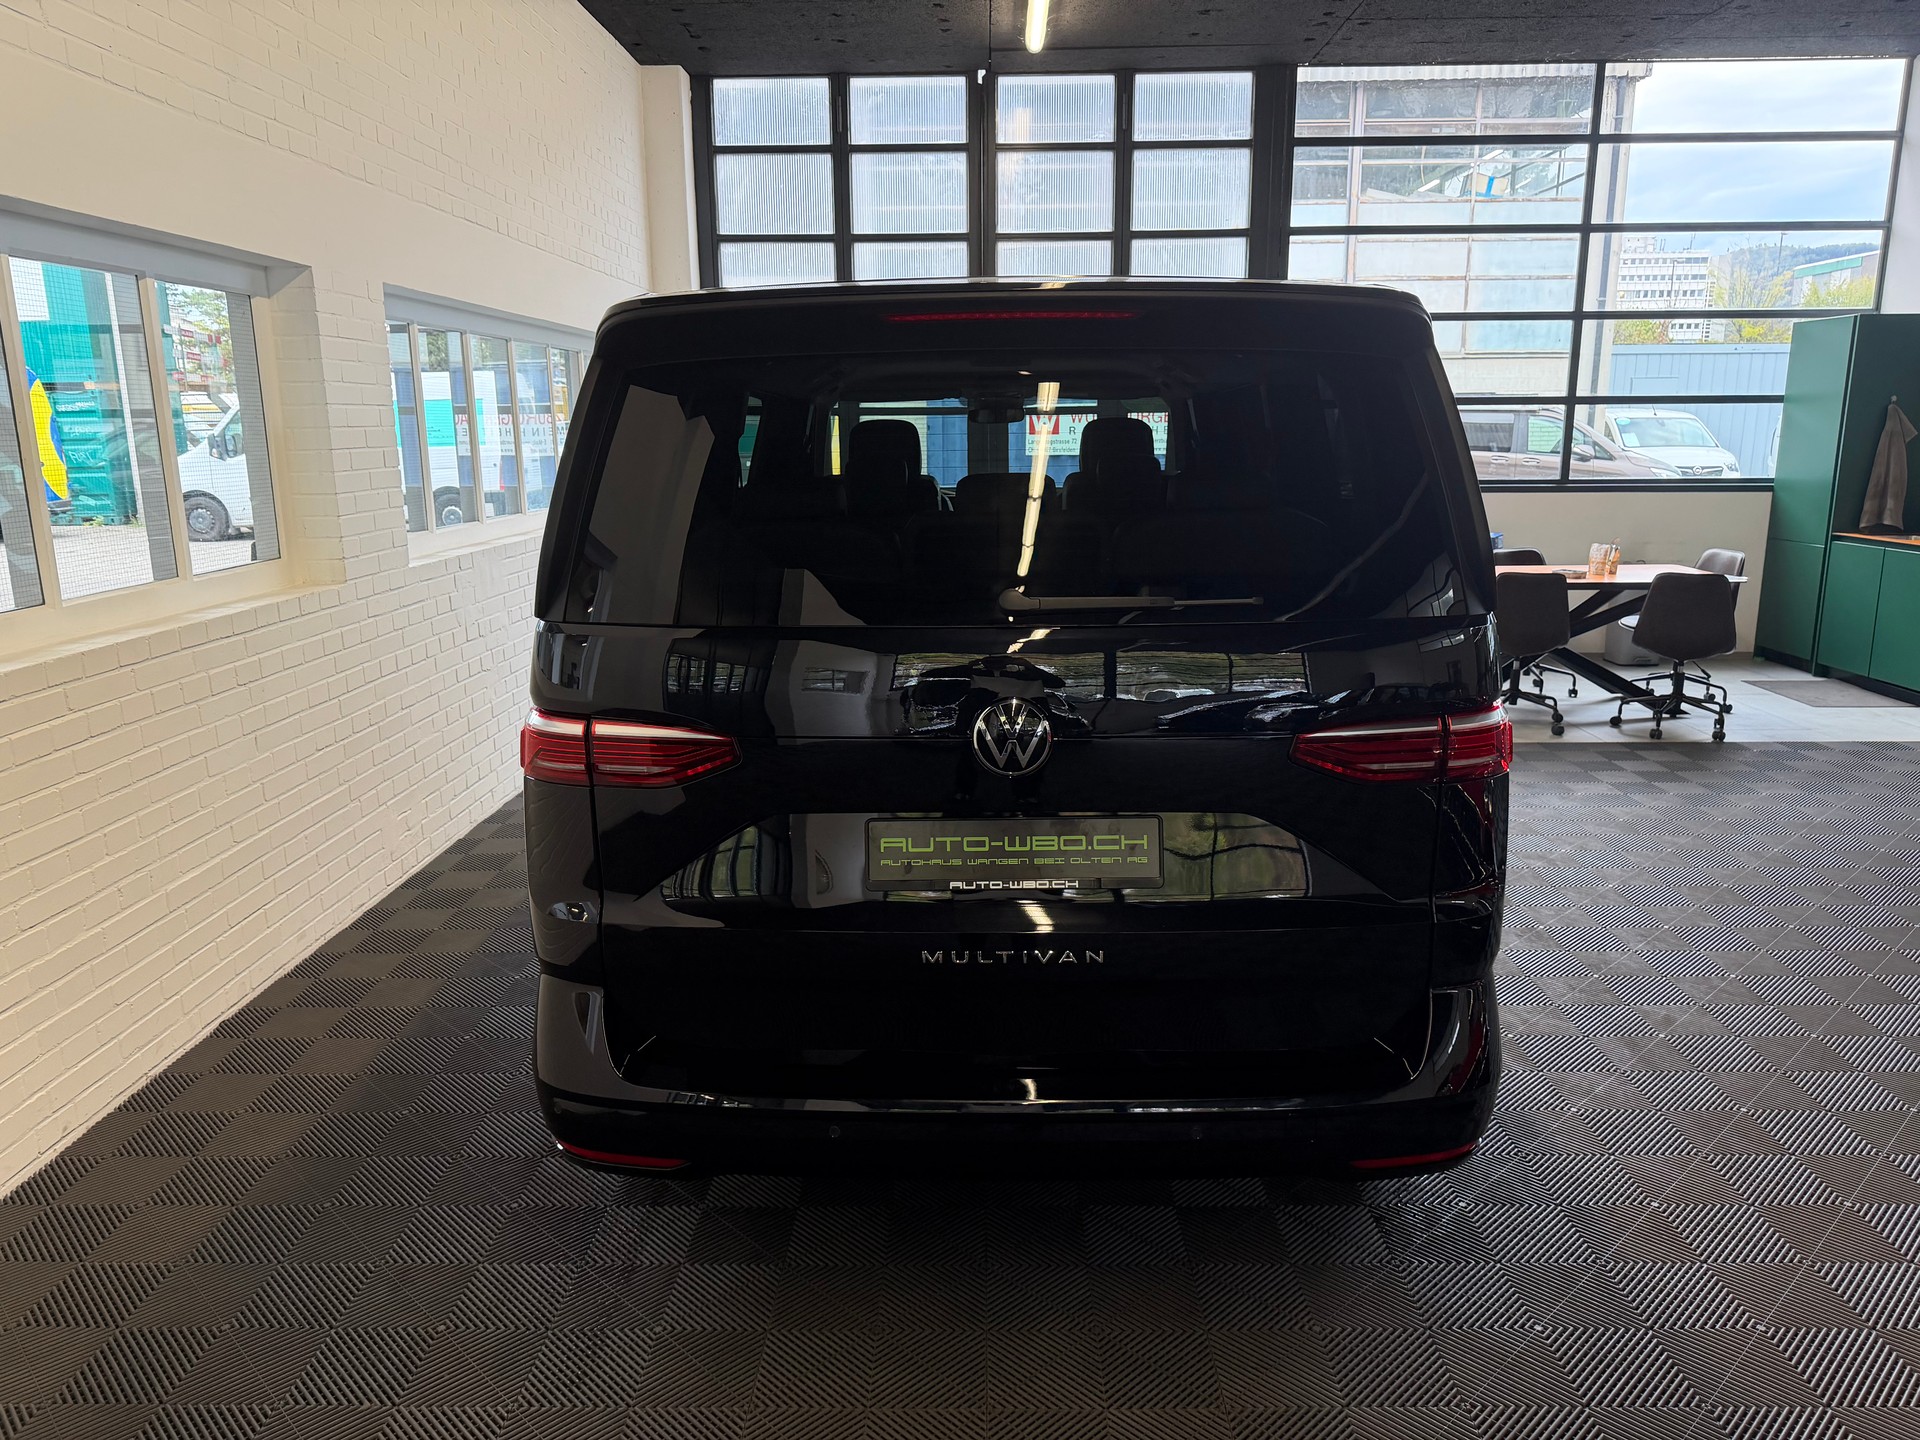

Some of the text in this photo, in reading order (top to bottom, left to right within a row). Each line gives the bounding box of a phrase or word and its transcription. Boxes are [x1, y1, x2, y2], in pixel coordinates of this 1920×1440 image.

[879, 835, 1148, 853] AUTO-WBO.CH
[880, 857, 1148, 867] AUTOHAUS WANGEN BEI OLTEN AG
[949, 879, 1080, 890] AUTO-WBO.CH
[921, 949, 1105, 964] MULTIVAN
